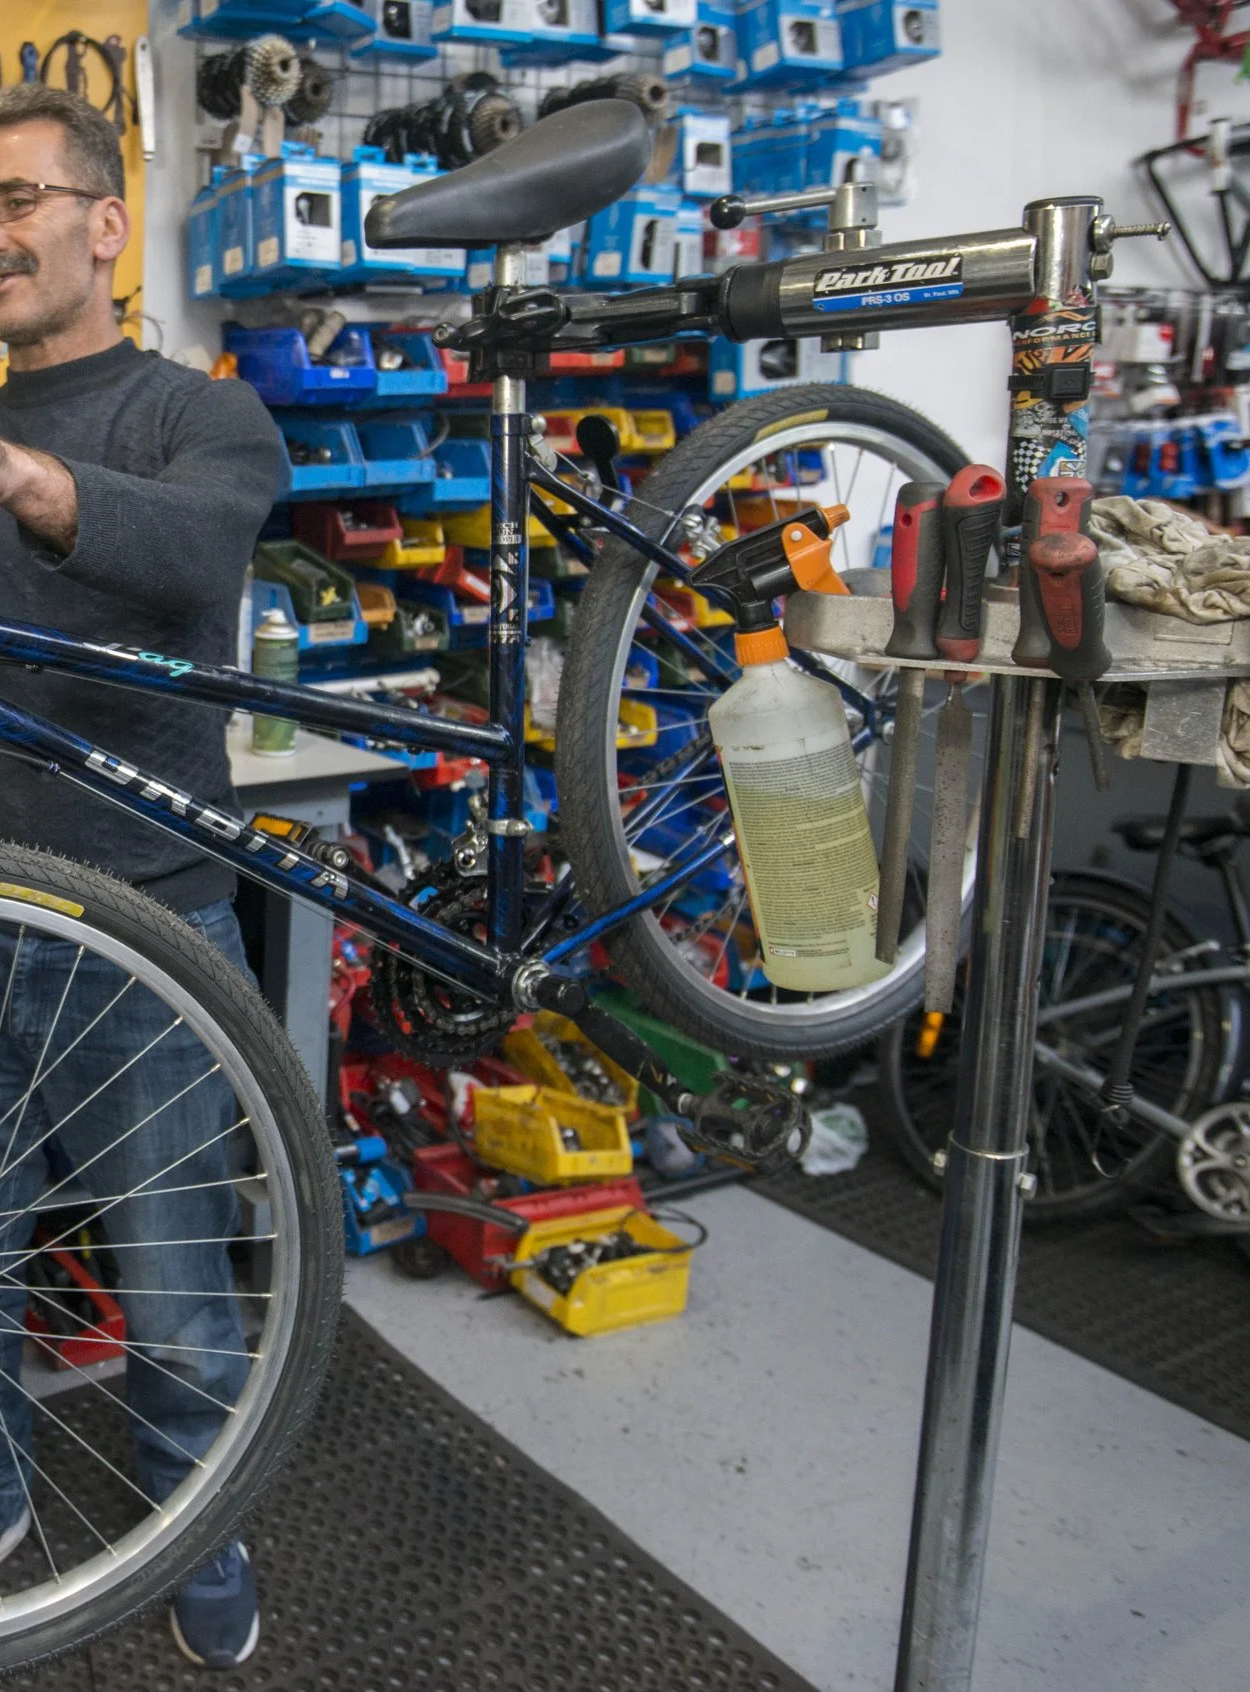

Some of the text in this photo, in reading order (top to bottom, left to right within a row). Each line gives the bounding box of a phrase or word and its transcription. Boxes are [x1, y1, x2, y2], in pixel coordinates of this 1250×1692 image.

[815, 257, 962, 292] Park Tool
[862, 292, 910, 306] PRS-3 OS
[1014, 332, 1091, 345] RFORMANCE
